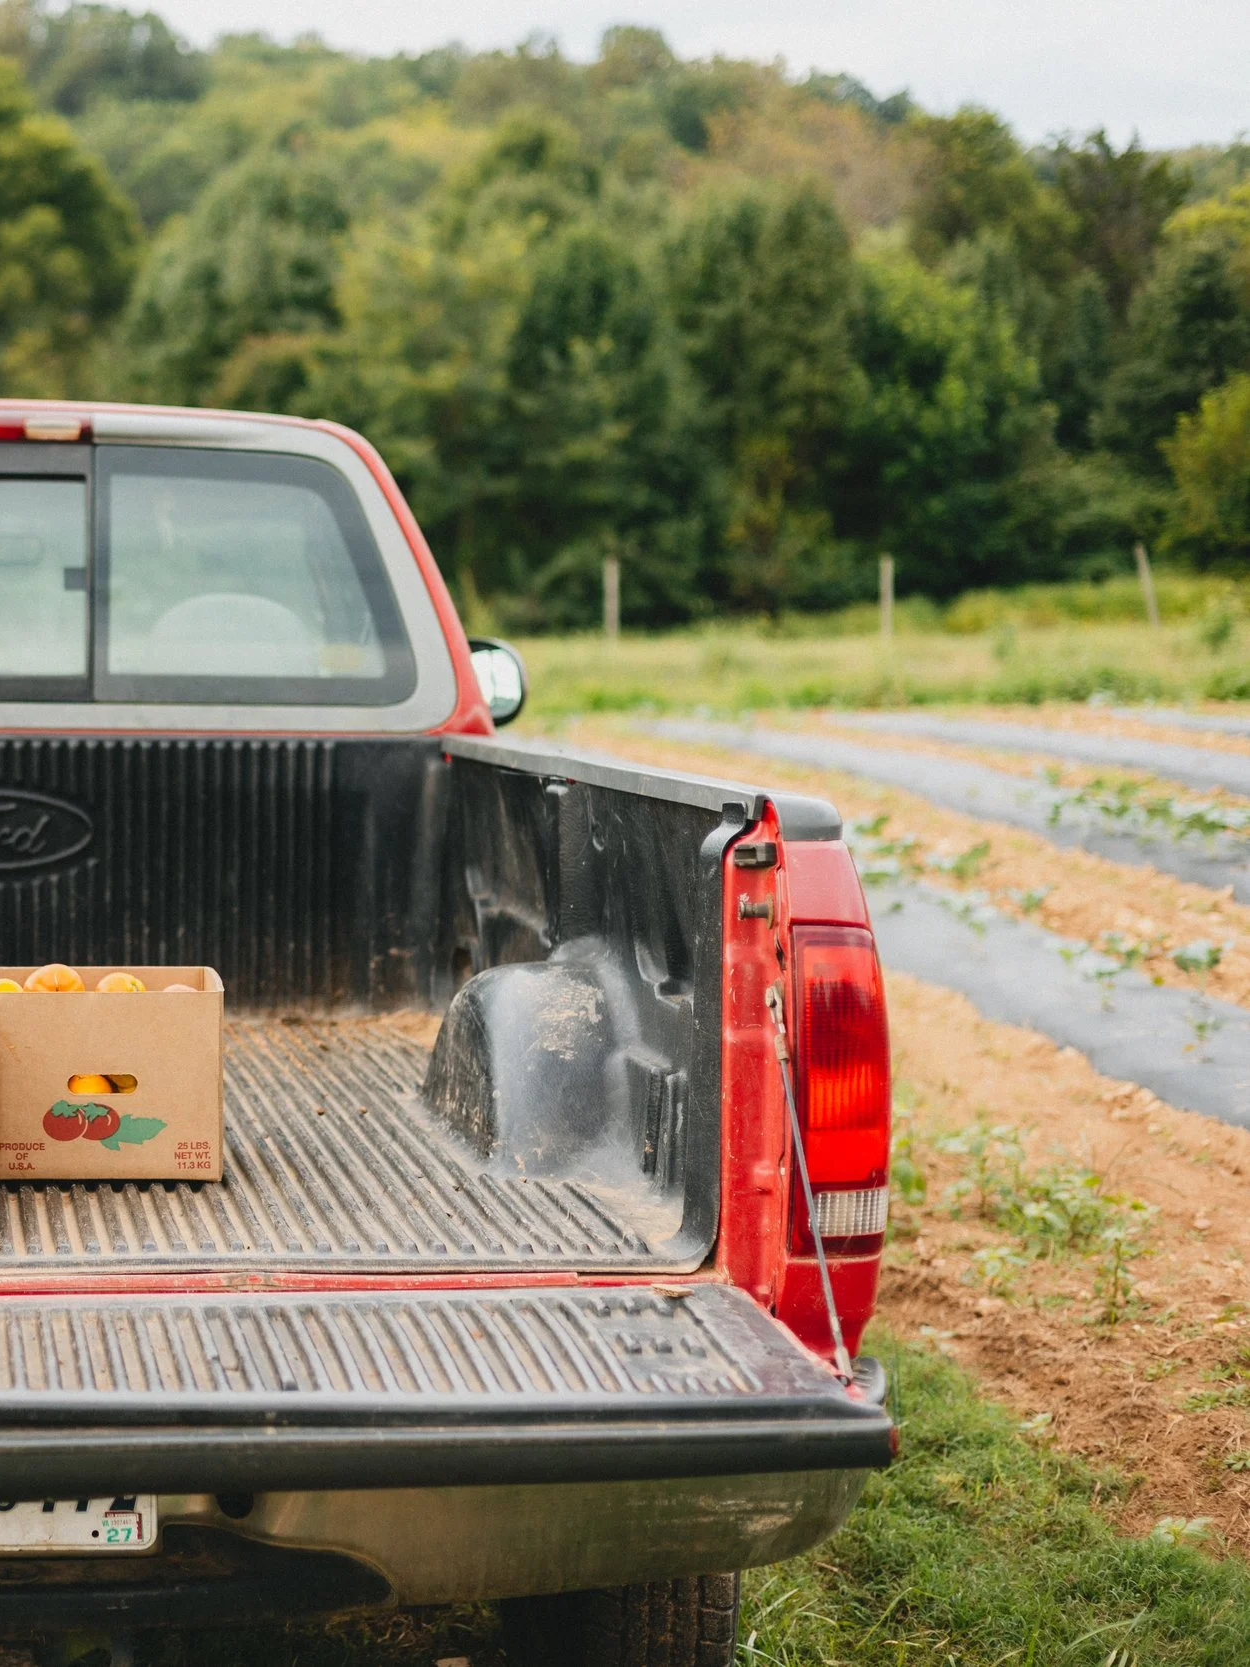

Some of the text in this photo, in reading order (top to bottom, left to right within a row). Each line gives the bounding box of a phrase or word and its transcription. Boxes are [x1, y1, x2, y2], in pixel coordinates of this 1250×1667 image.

[177, 1142, 211, 1150] 25 LBS.
[15, 1152, 28, 1161] OF
[174, 1152, 211, 1160] NET WT.
[8, 1162, 35, 1170] U.S.A.
[177, 1161, 211, 1169] 11.3 KG
[106, 1527, 132, 1543] 27
